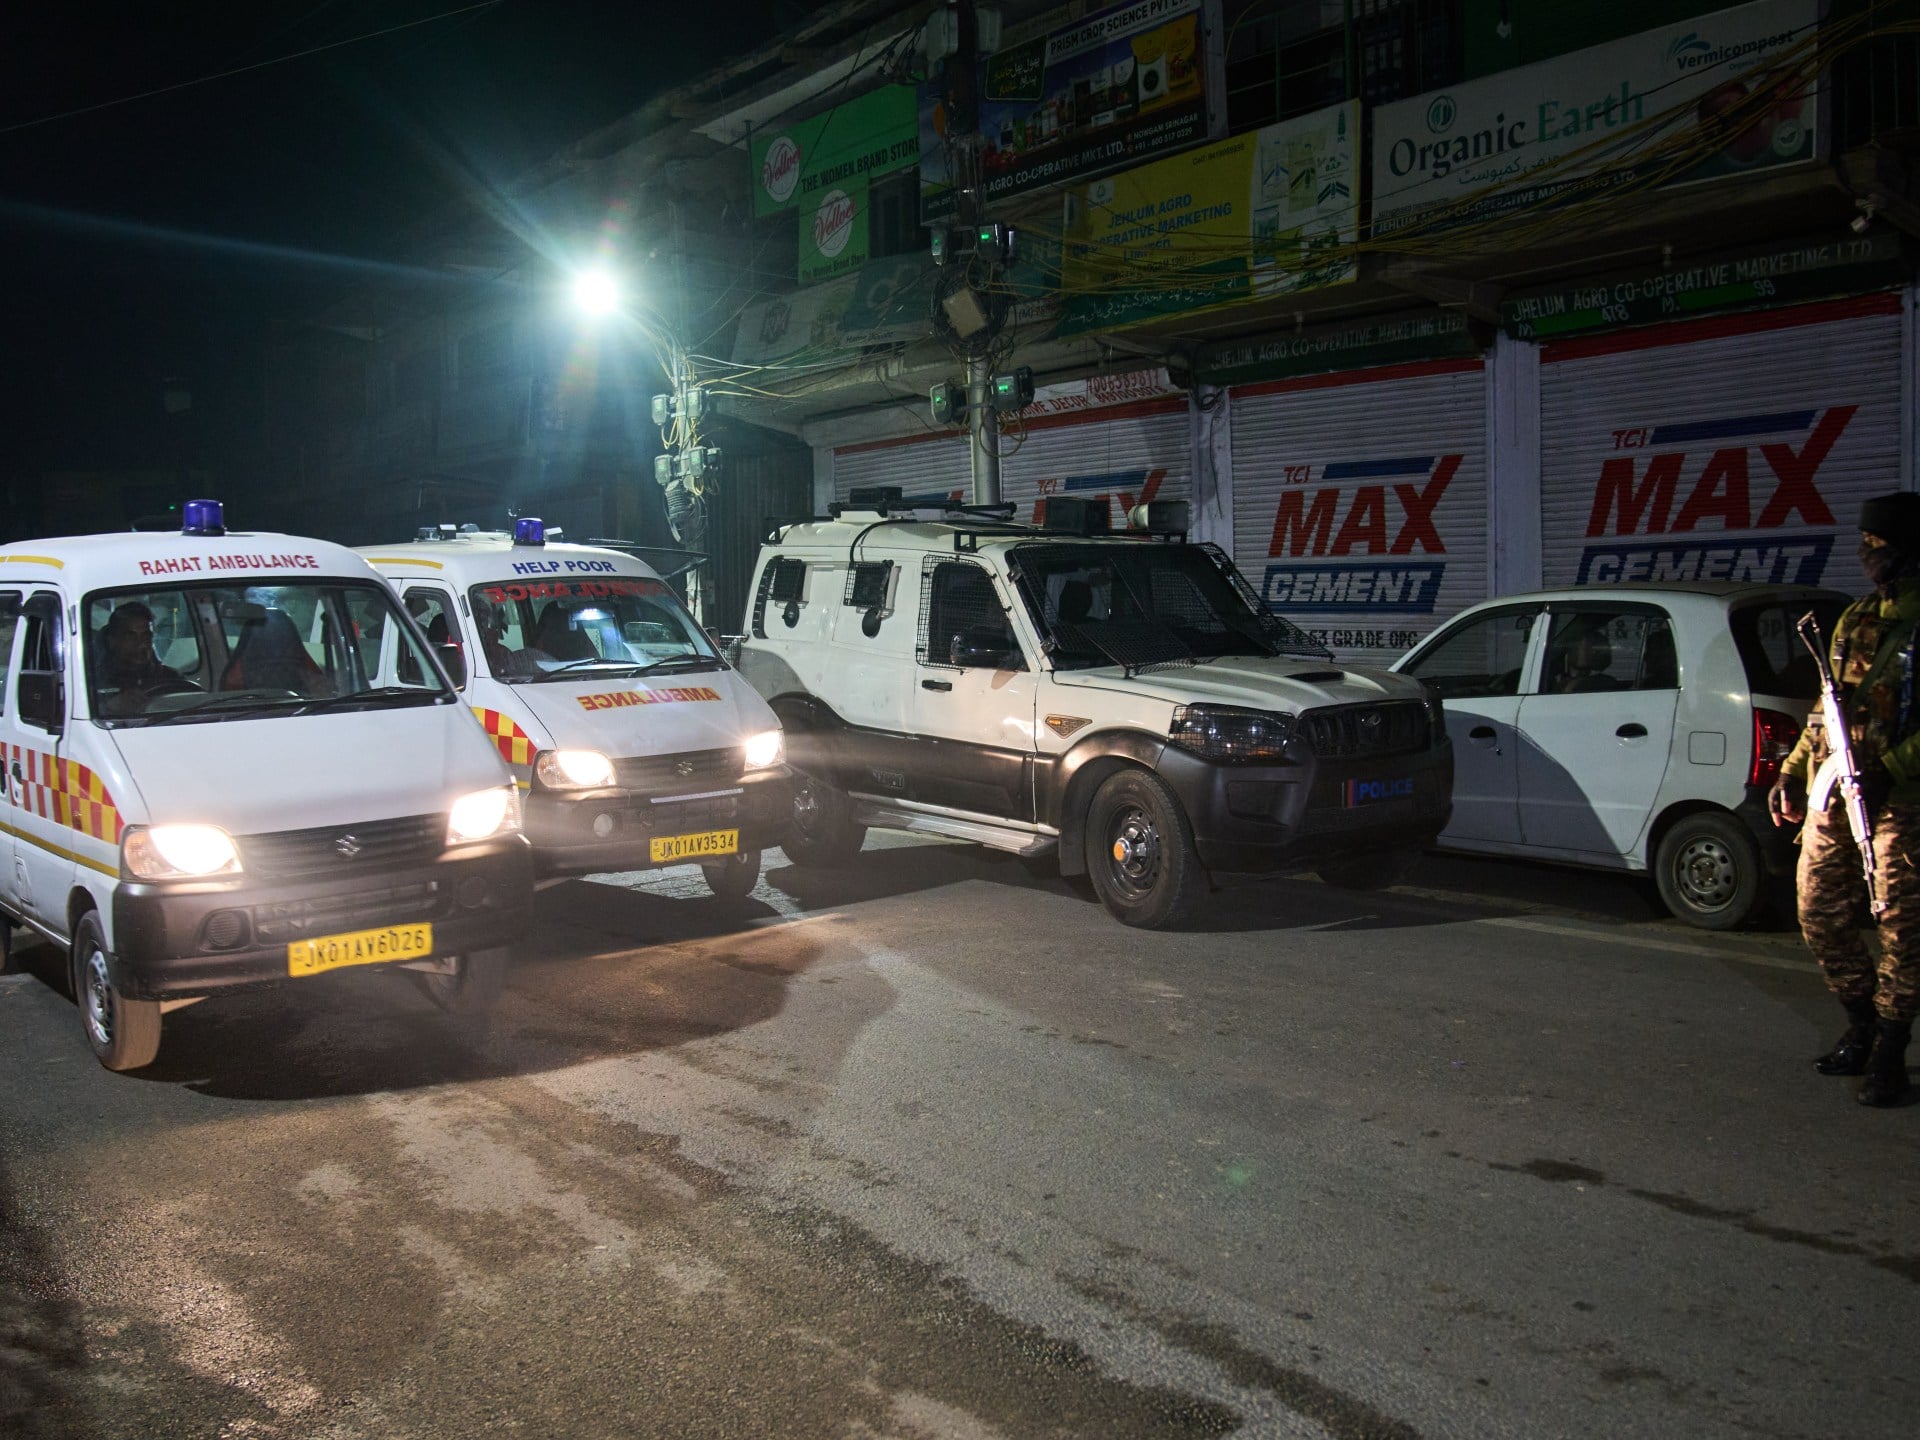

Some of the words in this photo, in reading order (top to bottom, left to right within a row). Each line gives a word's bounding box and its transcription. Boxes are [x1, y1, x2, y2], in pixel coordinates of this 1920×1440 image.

[1050, 31, 1079, 54] PRISM
[1081, 20, 1105, 43] CROP
[1106, 5, 1148, 33] SCIENCE
[1677, 30, 1794, 69] Vermicompost
[1389, 112, 1526, 179] Organic
[1538, 79, 1642, 143] Earth
[801, 174, 818, 193] THE
[819, 160, 855, 187] WOMEN
[856, 148, 889, 174] BRAND
[989, 176, 1014, 194] AGRO
[1159, 194, 1193, 215] AGRO
[1157, 201, 1233, 235] MARKETING
[1511, 295, 1565, 321] JHELUM
[1573, 288, 1608, 311] AGRO
[1614, 265, 1729, 304] CO-OPERATIVE
[1735, 246, 1829, 282] MARKETING
[1837, 239, 1872, 262] LTD
[1258, 341, 1287, 361] AGRO
[1050, 395, 1091, 411] DECOR
[1611, 428, 1646, 450] TCI
[1283, 465, 1310, 484] TCI
[1586, 405, 1858, 538] MAX
[1037, 479, 1057, 495] TCI
[1268, 454, 1464, 558] MAX
[138, 557, 202, 575] RAHAT
[208, 554, 319, 570] AMBULANCE
[512, 560, 560, 575] HELP
[565, 560, 617, 573] POOR
[1587, 546, 1817, 583] CEMENT
[1269, 570, 1433, 602] CEMENT
[1332, 630, 1385, 649] GRADE
[1390, 630, 1418, 649] OPC
[1359, 778, 1415, 800] POLICE
[660, 833, 734, 858] JK01AV3534
[305, 929, 426, 968] JK01AV6026
